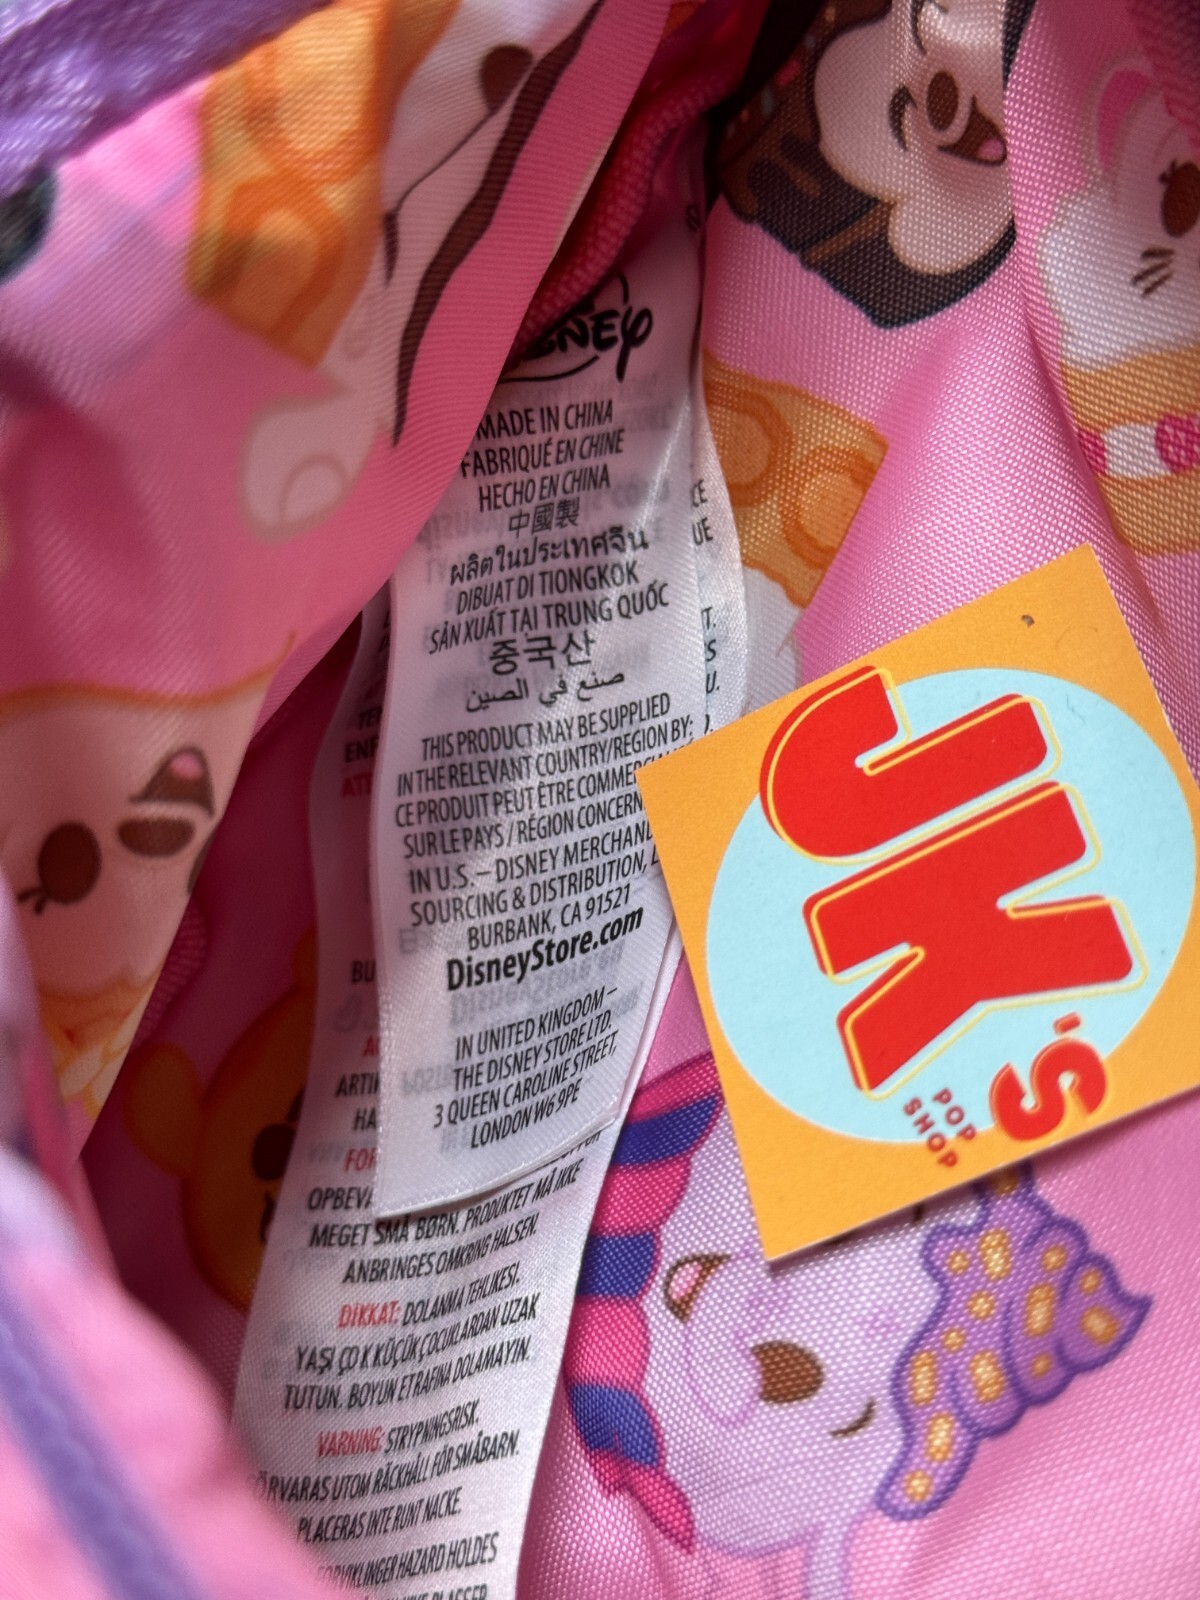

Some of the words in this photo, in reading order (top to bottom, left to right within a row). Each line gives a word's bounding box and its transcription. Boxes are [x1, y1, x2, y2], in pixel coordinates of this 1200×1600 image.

[476, 408, 535, 440] MADE
[540, 405, 560, 432] IN
[564, 399, 613, 430] CHINA
[460, 437, 552, 478] FABRIQUÉ
[556, 439, 576, 463] EN
[578, 429, 626, 459] CHINE
[478, 482, 536, 512] HECHO
[539, 475, 558, 499] EN
[561, 463, 611, 494] CHINA
[508, 497, 580, 539] 中國製
[456, 578, 515, 616] DIBUAT
[518, 574, 535, 600] DI
[539, 560, 640, 596] TIONGKOK
[542, 596, 613, 629] TRUNG
[489, 629, 596, 676] 중국산
[465, 678, 529, 713] الصين
[538, 674, 568, 708] في
[576, 670, 626, 702] صنع
[421, 732, 455, 761] THIS
[457, 722, 534, 756] PRODUCT
[538, 716, 574, 749] MAY
[578, 712, 598, 739] BE
[600, 692, 671, 734] SUPPLIED
[397, 773, 414, 797] IN
[416, 766, 447, 794] THE
[450, 755, 534, 790] RELEVANT
[535, 721, 668, 778] COUNTRY/REGION
[671, 714, 693, 743] BY:
[395, 802, 414, 828] CE
[416, 791, 490, 826] PRODUIT
[493, 784, 538, 816] PEUT
[537, 777, 575, 810] ÊTRE
[404, 829, 443, 859] SUR
[443, 826, 463, 853] LE
[463, 821, 504, 851] PAYS
[518, 810, 574, 844] RÉGION
[577, 790, 645, 830] CONCERN
[408, 867, 431, 894] IN
[496, 847, 559, 882] DISNEY
[410, 890, 508, 927] SOURCING
[512, 889, 526, 910] &
[529, 849, 647, 904] DISTRIBUTION,
[468, 910, 557, 951] BURBANK,
[560, 903, 582, 928] CA
[584, 884, 631, 919] 91521
[447, 906, 645, 991] DisneyStore.com
[455, 1034, 473, 1060] IN
[477, 1016, 535, 1055] UNITED
[537, 985, 606, 1040] KINGDOM
[454, 1062, 487, 1092] THE
[487, 1042, 541, 1082] DISNEY
[543, 1023, 585, 1066] STORE
[585, 1010, 612, 1045] LTD.
[433, 1103, 444, 1128] 3
[449, 1086, 500, 1126] QUEEN
[503, 1056, 570, 1105] CAROLINE
[569, 1029, 620, 1075] STREET,
[470, 1105, 532, 1149] LONDON
[902, 1096, 959, 1168] SHOP
[932, 1087, 977, 1141] POP
[308, 1222, 373, 1248] MEGET
[414, 1212, 459, 1241] BØRN.
[462, 1182, 535, 1233] PRODUKTET
[342, 1252, 435, 1285] ANBRINGES
[435, 1233, 492, 1273] OMKRING
[402, 1285, 465, 1327] DOLANMA
[501, 1292, 540, 1326] UZAK
[347, 1377, 398, 1409] BOYUN
[398, 1360, 452, 1402] ETRAFINA
[384, 1398, 480, 1454] STRYPNINGSRISK.
[332, 1471, 373, 1501] UTOM
[399, 1543, 446, 1579] HAZARD
[446, 1531, 500, 1568] HOLDES
